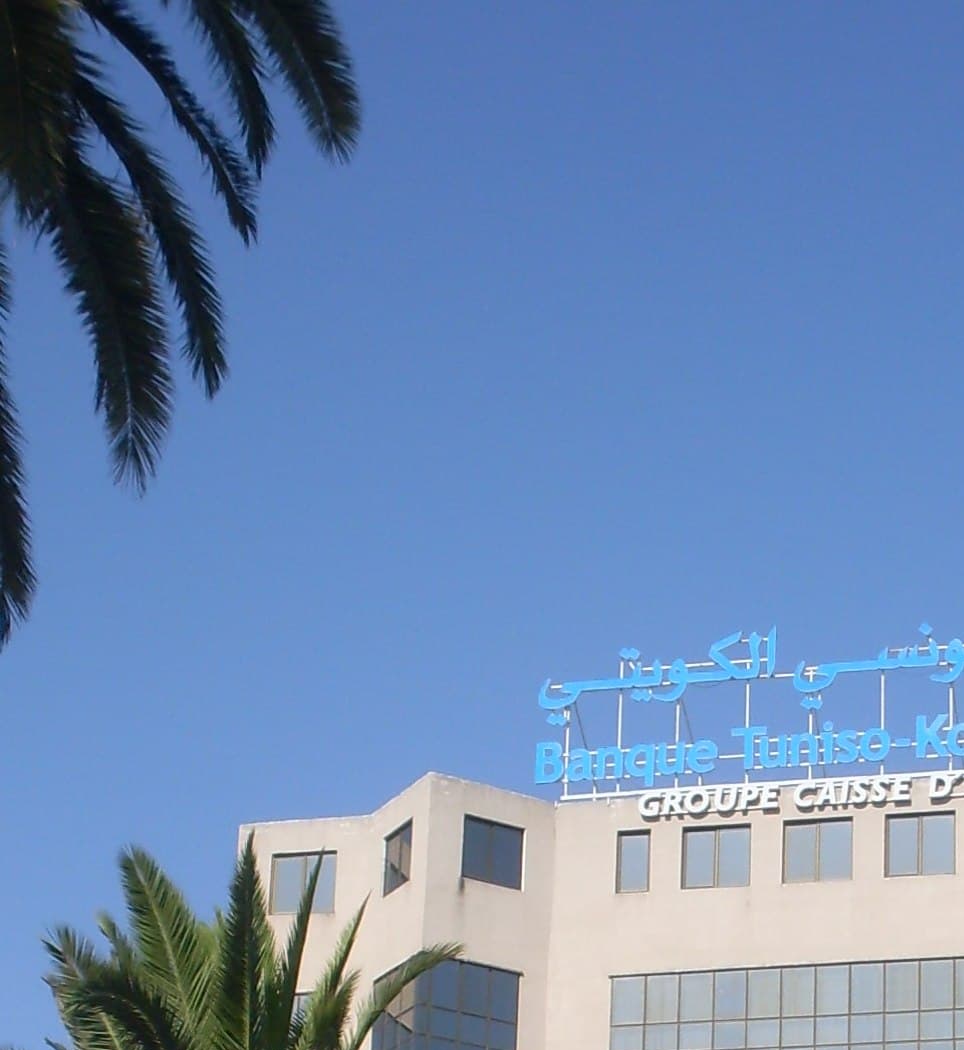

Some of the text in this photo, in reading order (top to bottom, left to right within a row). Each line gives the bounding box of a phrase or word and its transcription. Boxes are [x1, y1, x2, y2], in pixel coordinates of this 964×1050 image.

[538, 624, 777, 726] الكويتي
[535, 739, 718, 787] Banque
[638, 784, 780, 817] GROUPE
[793, 776, 912, 808] CAISSE
